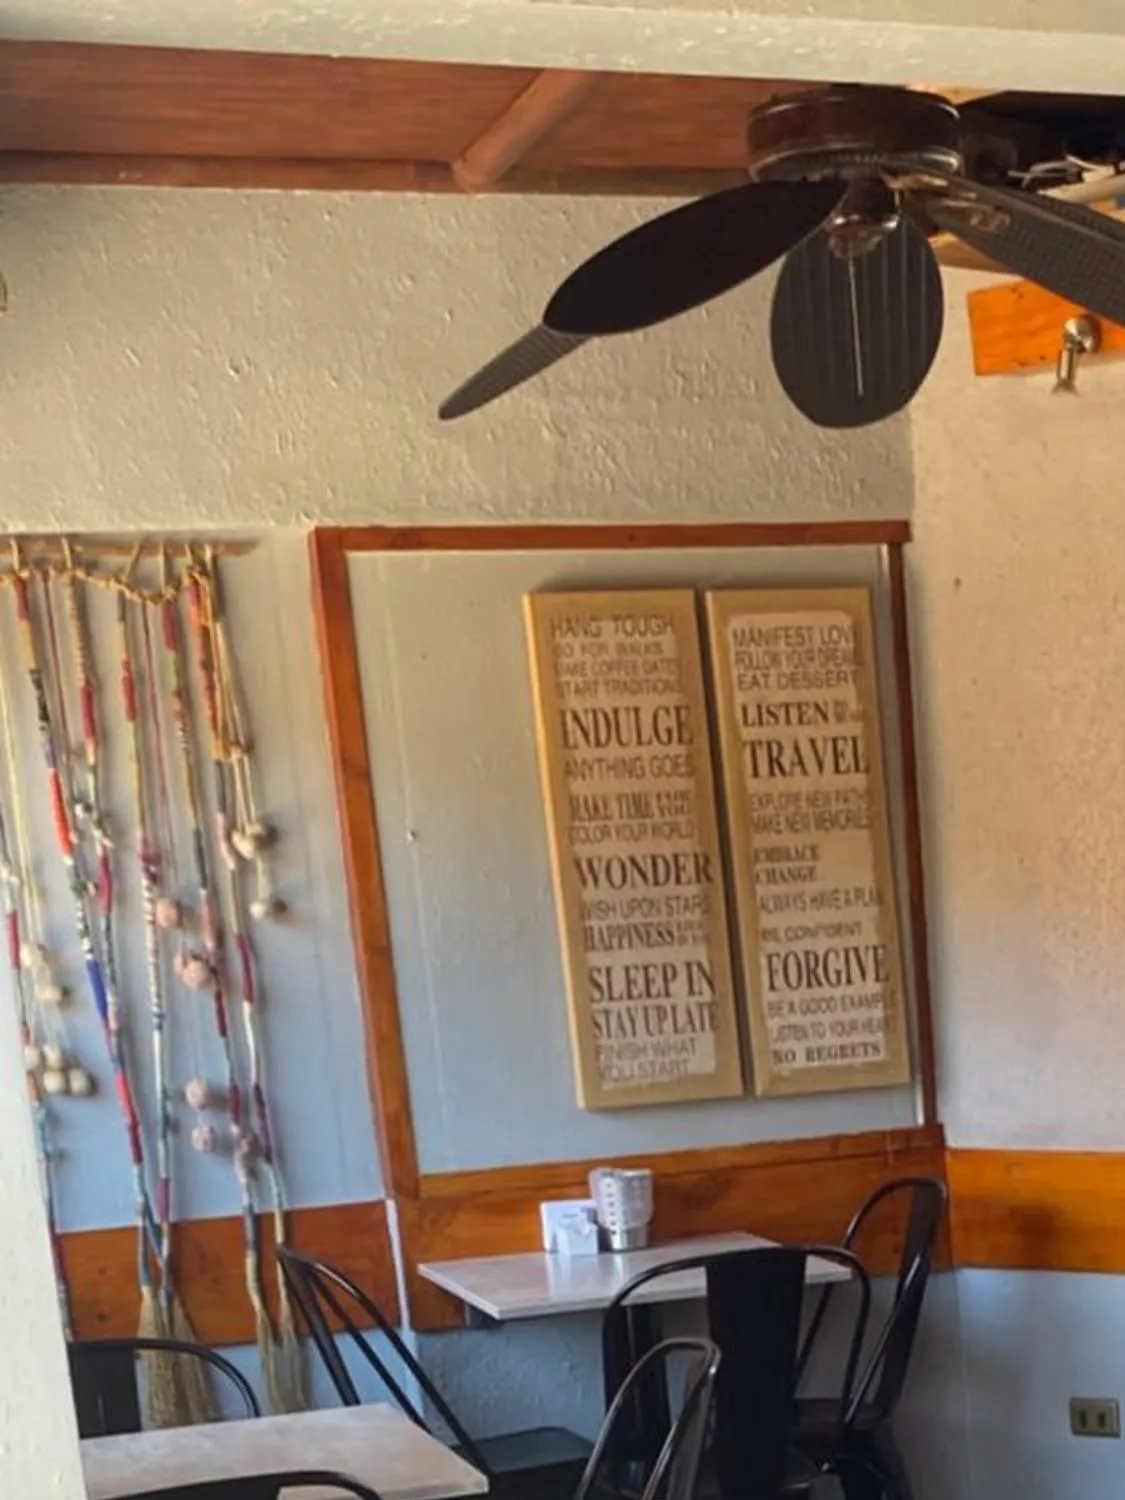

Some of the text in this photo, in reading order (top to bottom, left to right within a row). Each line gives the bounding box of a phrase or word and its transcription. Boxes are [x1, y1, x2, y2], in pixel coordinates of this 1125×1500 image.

[550, 613, 675, 638] HANG TOUGH
[733, 626, 815, 647] MANIFEST
[593, 661, 641, 676] COFFEE
[738, 674, 770, 690] EAT
[559, 704, 695, 749] INDULGE
[742, 702, 830, 726] LISTEN
[564, 754, 696, 781] ANYTHING GOES
[743, 736, 871, 778] TRAVEL
[569, 795, 612, 822] MAKE
[616, 792, 654, 819] TIME
[615, 824, 648, 841] YOUR
[652, 821, 697, 839] WORLD
[574, 852, 714, 891] WONDER
[756, 866, 817, 884] CHANGE
[583, 921, 675, 951] HAPPINESS
[588, 960, 716, 1002] SLEEP IN
[766, 945, 890, 991] FORGIVE
[789, 1001, 797, 1014] A
[800, 997, 838, 1015] GOOD
[591, 1001, 721, 1039] STAY UP LATE
[773, 1042, 881, 1064] NO REGRETS
